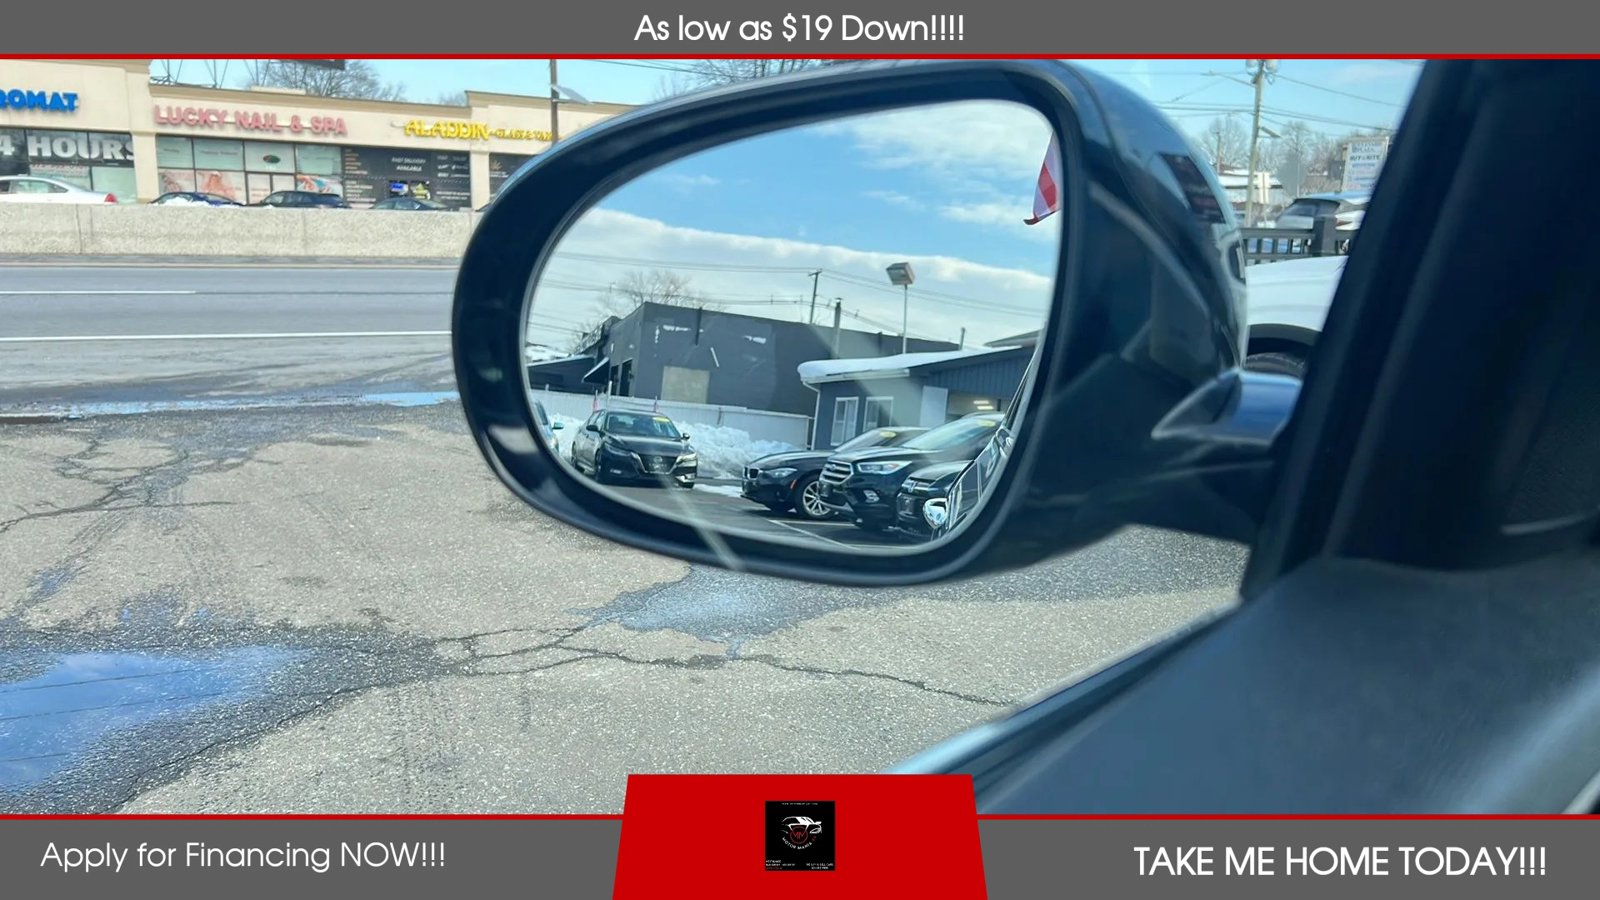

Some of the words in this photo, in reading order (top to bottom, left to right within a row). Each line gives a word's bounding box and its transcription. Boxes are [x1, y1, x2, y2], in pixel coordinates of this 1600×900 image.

[154, 105, 228, 127] LUCKY
[234, 110, 283, 132] NAIL
[290, 114, 303, 133] &
[310, 116, 348, 136] SPA
[404, 119, 489, 140] ALADDIN
